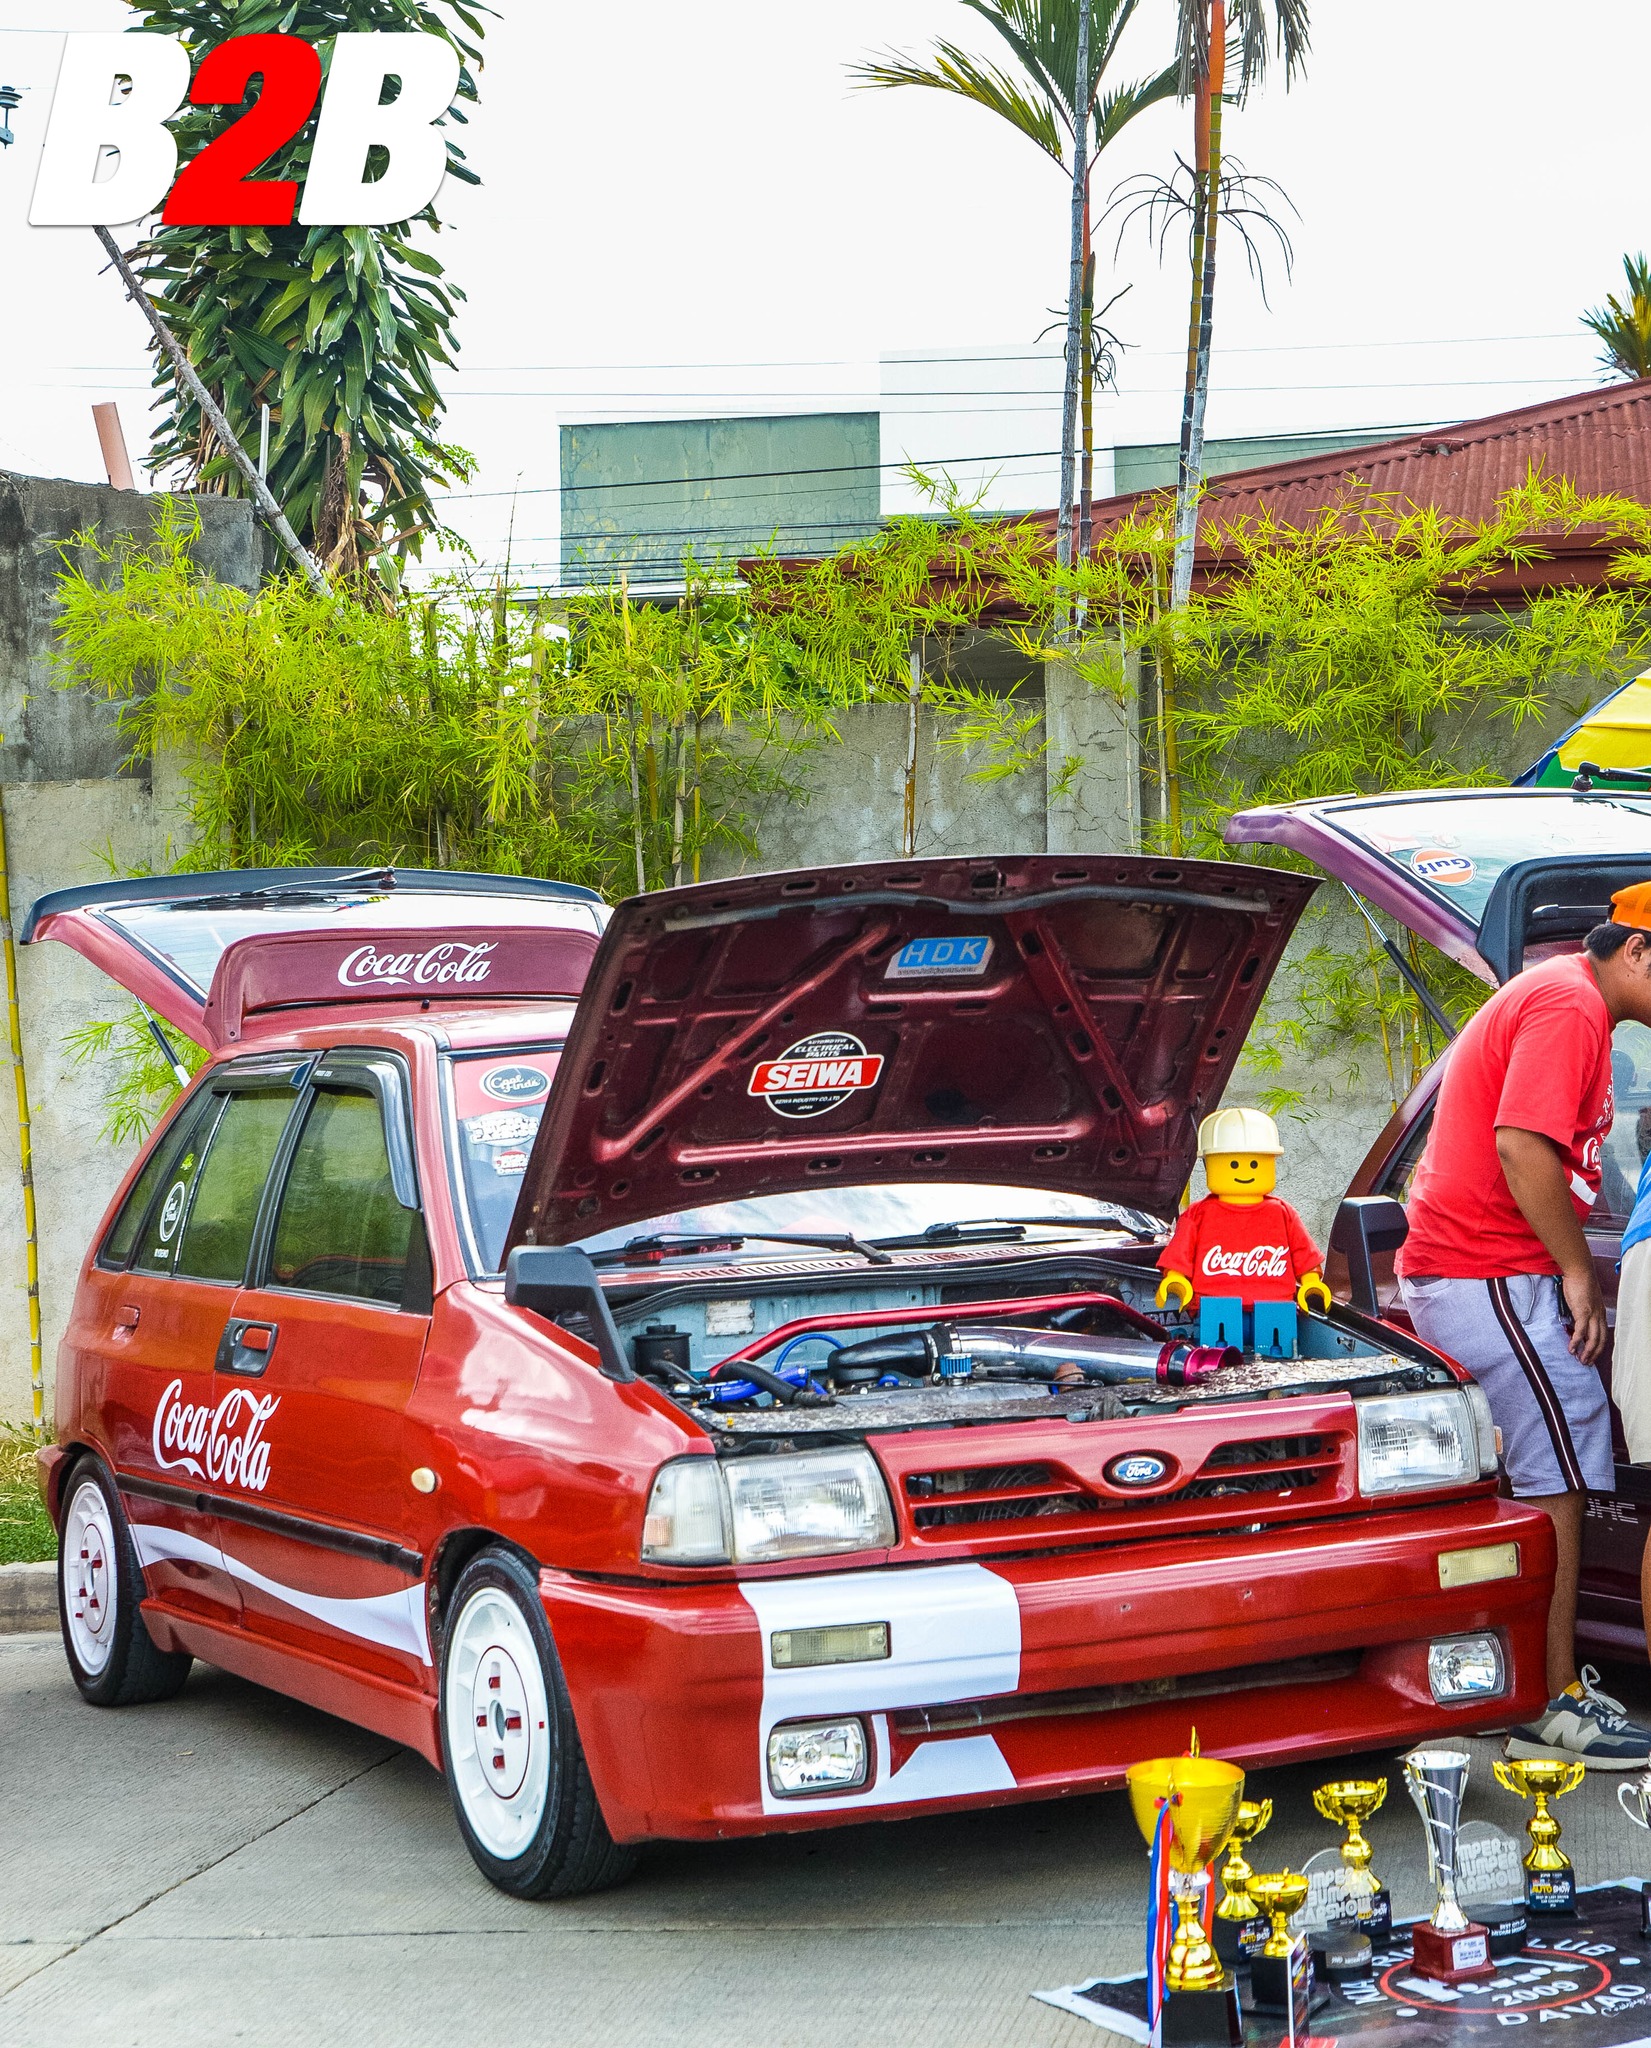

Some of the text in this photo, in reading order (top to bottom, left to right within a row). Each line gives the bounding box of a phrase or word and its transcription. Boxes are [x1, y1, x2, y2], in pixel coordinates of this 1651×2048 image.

[1417, 858, 1471, 874] Gulf
[337, 942, 499, 987] Coca-Cola
[903, 941, 982, 964] HDK
[794, 1043, 856, 1054] ELECTRICAL
[805, 1050, 840, 1058] PARTS
[764, 1061, 863, 1090] SEIWA
[1202, 1245, 1289, 1277] Coca-Cola
[153, 1378, 282, 1491] Coca-Cola
[1126, 1462, 1153, 1478] Ford
[1458, 1838, 1501, 1861] MPER
[1456, 1868, 1521, 1897] ARSHOW
[1527, 1938, 1616, 1957] LUB
[1491, 1979, 1579, 2007] 2009
[1497, 1984, 1646, 2026] DAVAO
